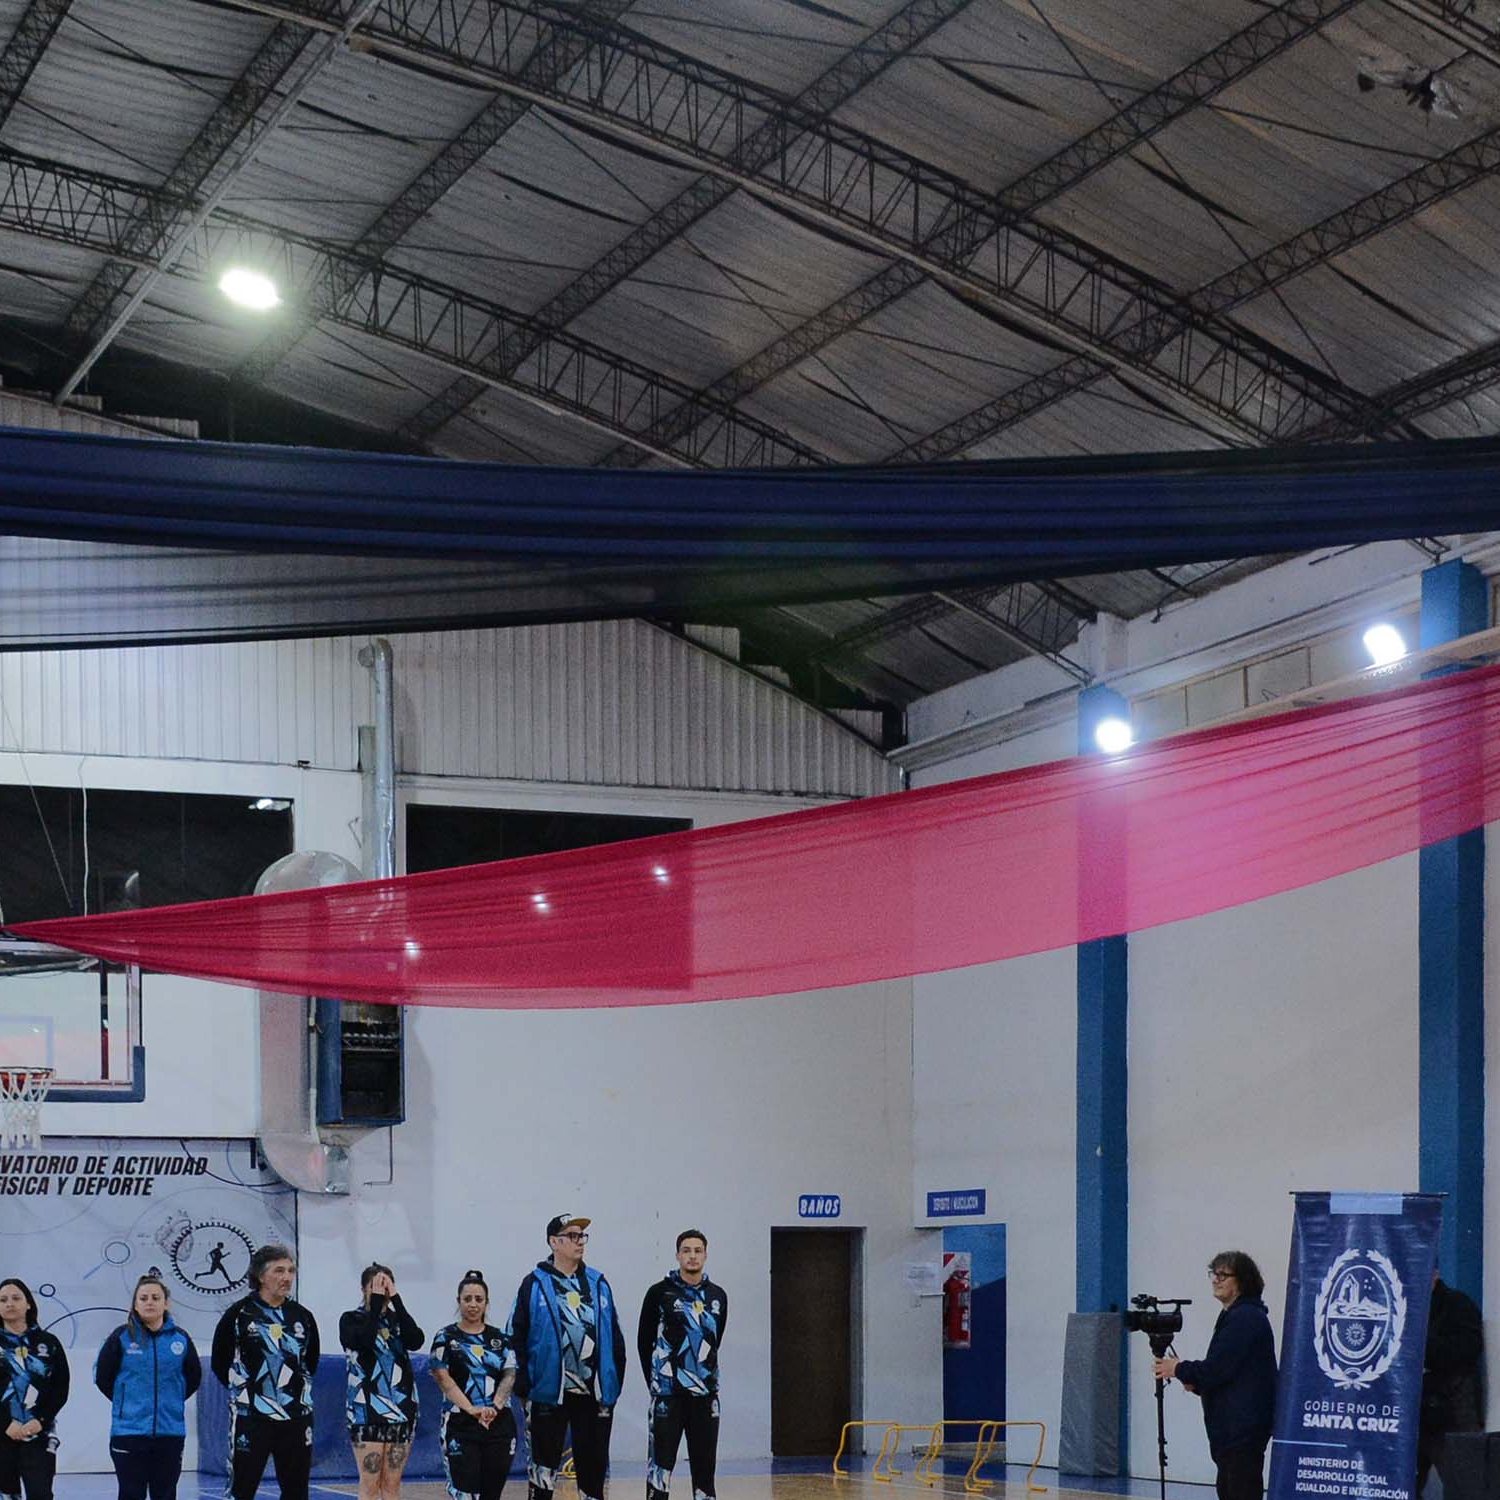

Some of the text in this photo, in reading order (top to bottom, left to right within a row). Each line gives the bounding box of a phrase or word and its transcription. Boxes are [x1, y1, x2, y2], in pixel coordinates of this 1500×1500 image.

[83, 1156, 108, 1175] DE
[112, 1156, 209, 1175] ACTIVIDAD
[56, 1177, 69, 1195] Y
[72, 1177, 155, 1196] DEPORTE
[800, 1196, 840, 1215] BAÑOS
[1304, 1400, 1400, 1417] GOBIERNO DE
[1302, 1413, 1399, 1433] SANTA CRUZ
[1298, 1456, 1364, 1470] MINISTERIO DE
[1297, 1469, 1388, 1485] DESARROLLO SOCIAL
[1295, 1482, 1409, 1500] IGUALDAD E INTEGRACIÓN
